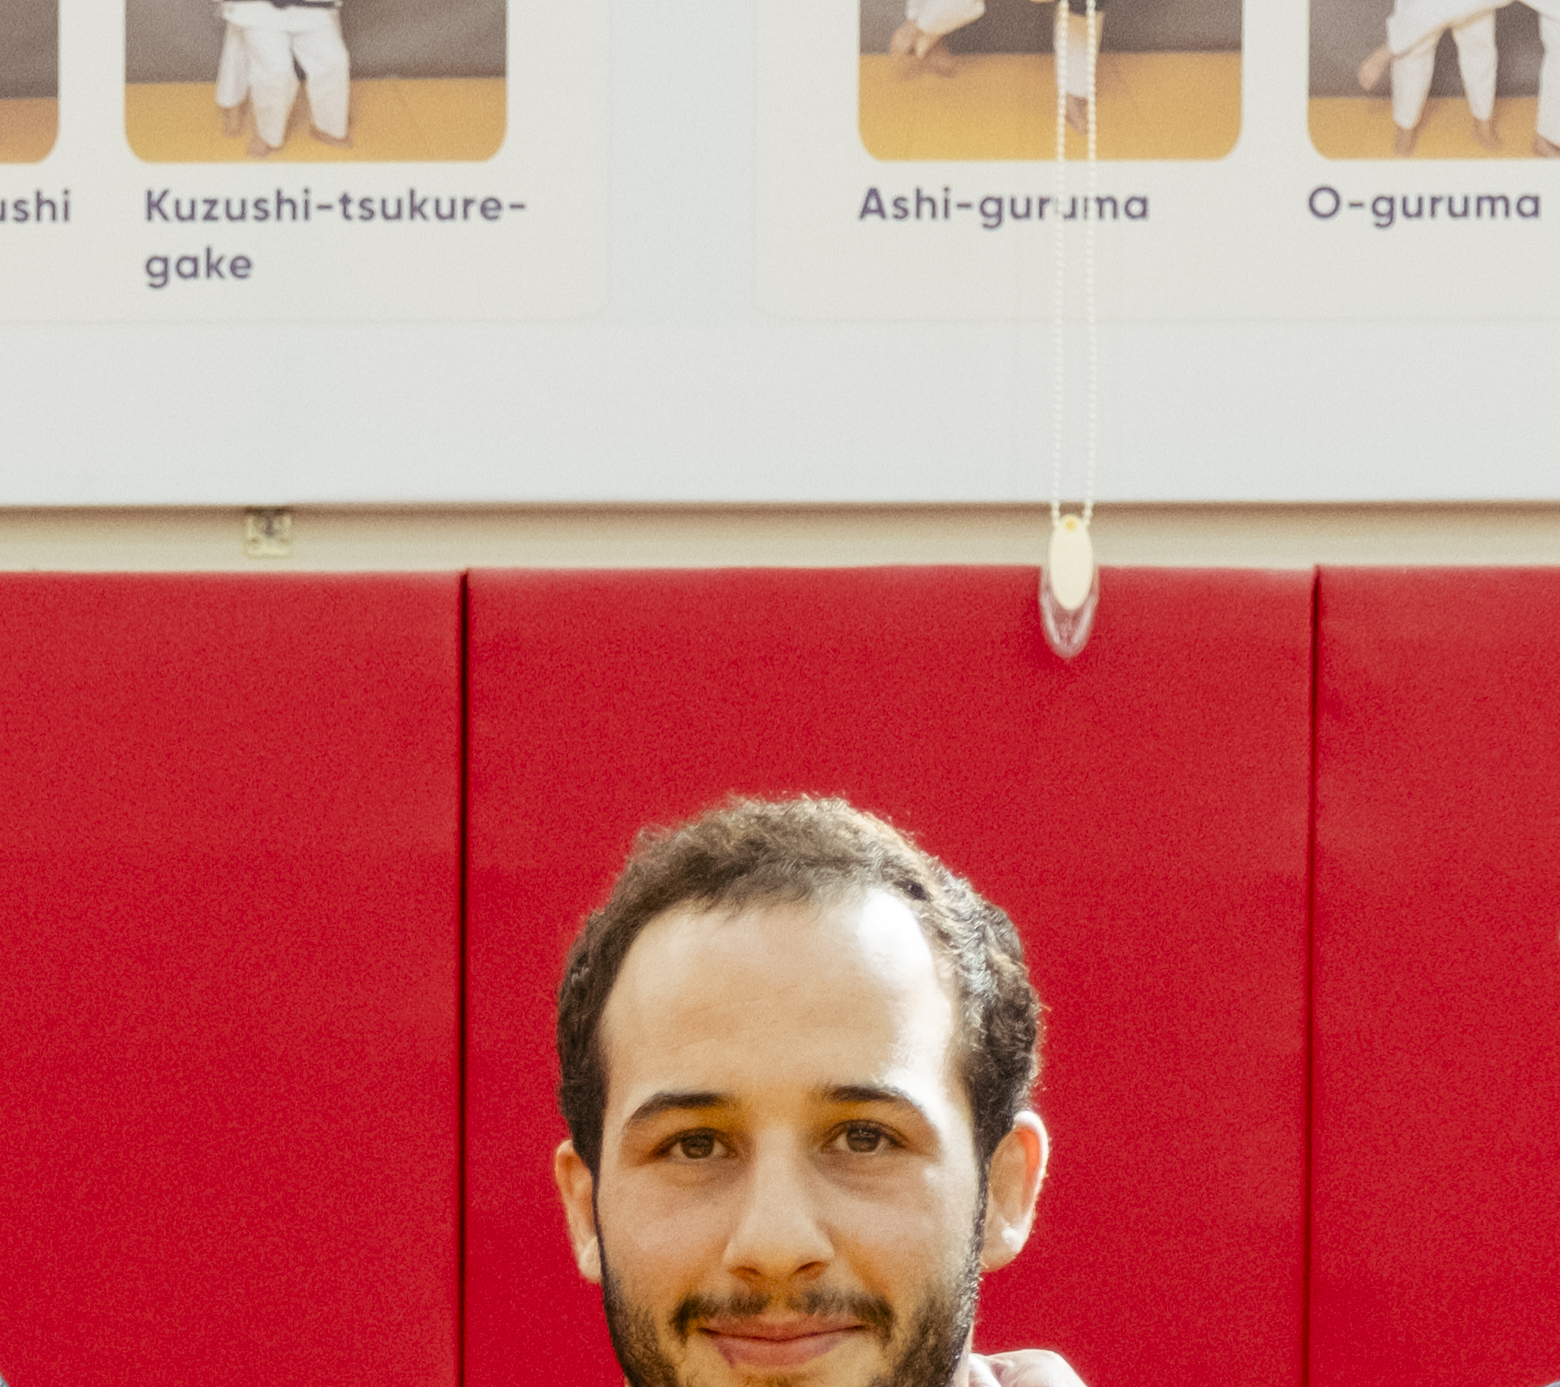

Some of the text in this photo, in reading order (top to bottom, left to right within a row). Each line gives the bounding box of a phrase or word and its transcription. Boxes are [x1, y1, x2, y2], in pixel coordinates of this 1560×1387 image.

[145, 188, 526, 222] Kuzushi-tsukure-
[1308, 186, 1541, 229] O-guruma
[145, 246, 253, 289] gake
